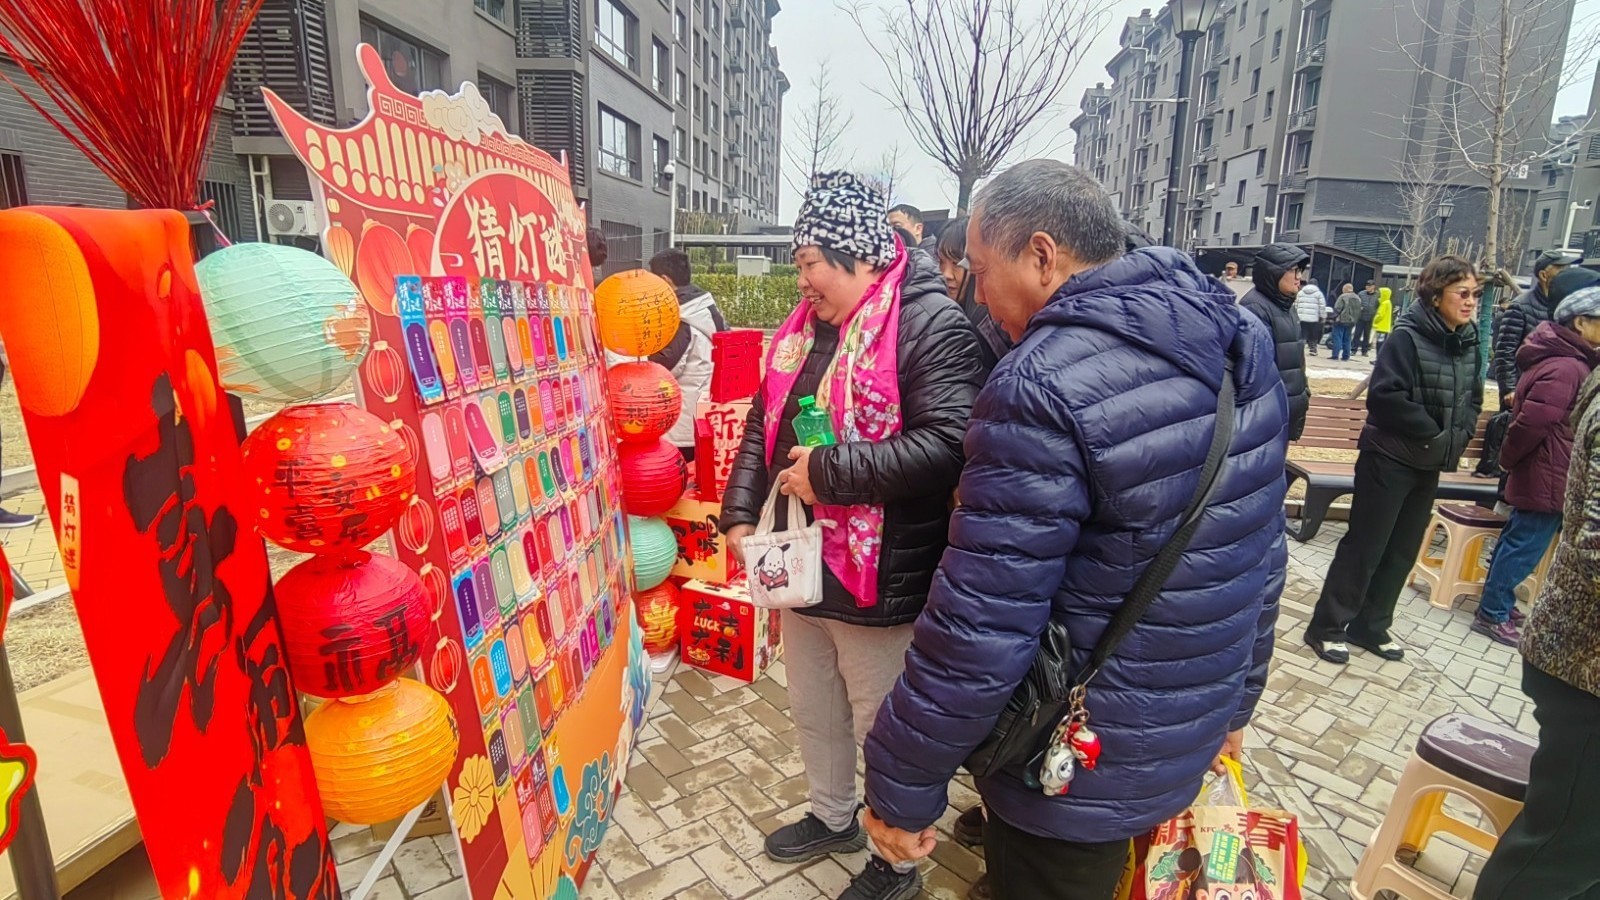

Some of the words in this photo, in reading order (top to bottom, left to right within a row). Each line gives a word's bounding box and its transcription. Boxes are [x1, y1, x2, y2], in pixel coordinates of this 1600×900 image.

[463, 193, 568, 281] 猜灯谜
[693, 616, 720, 632] LUCK
